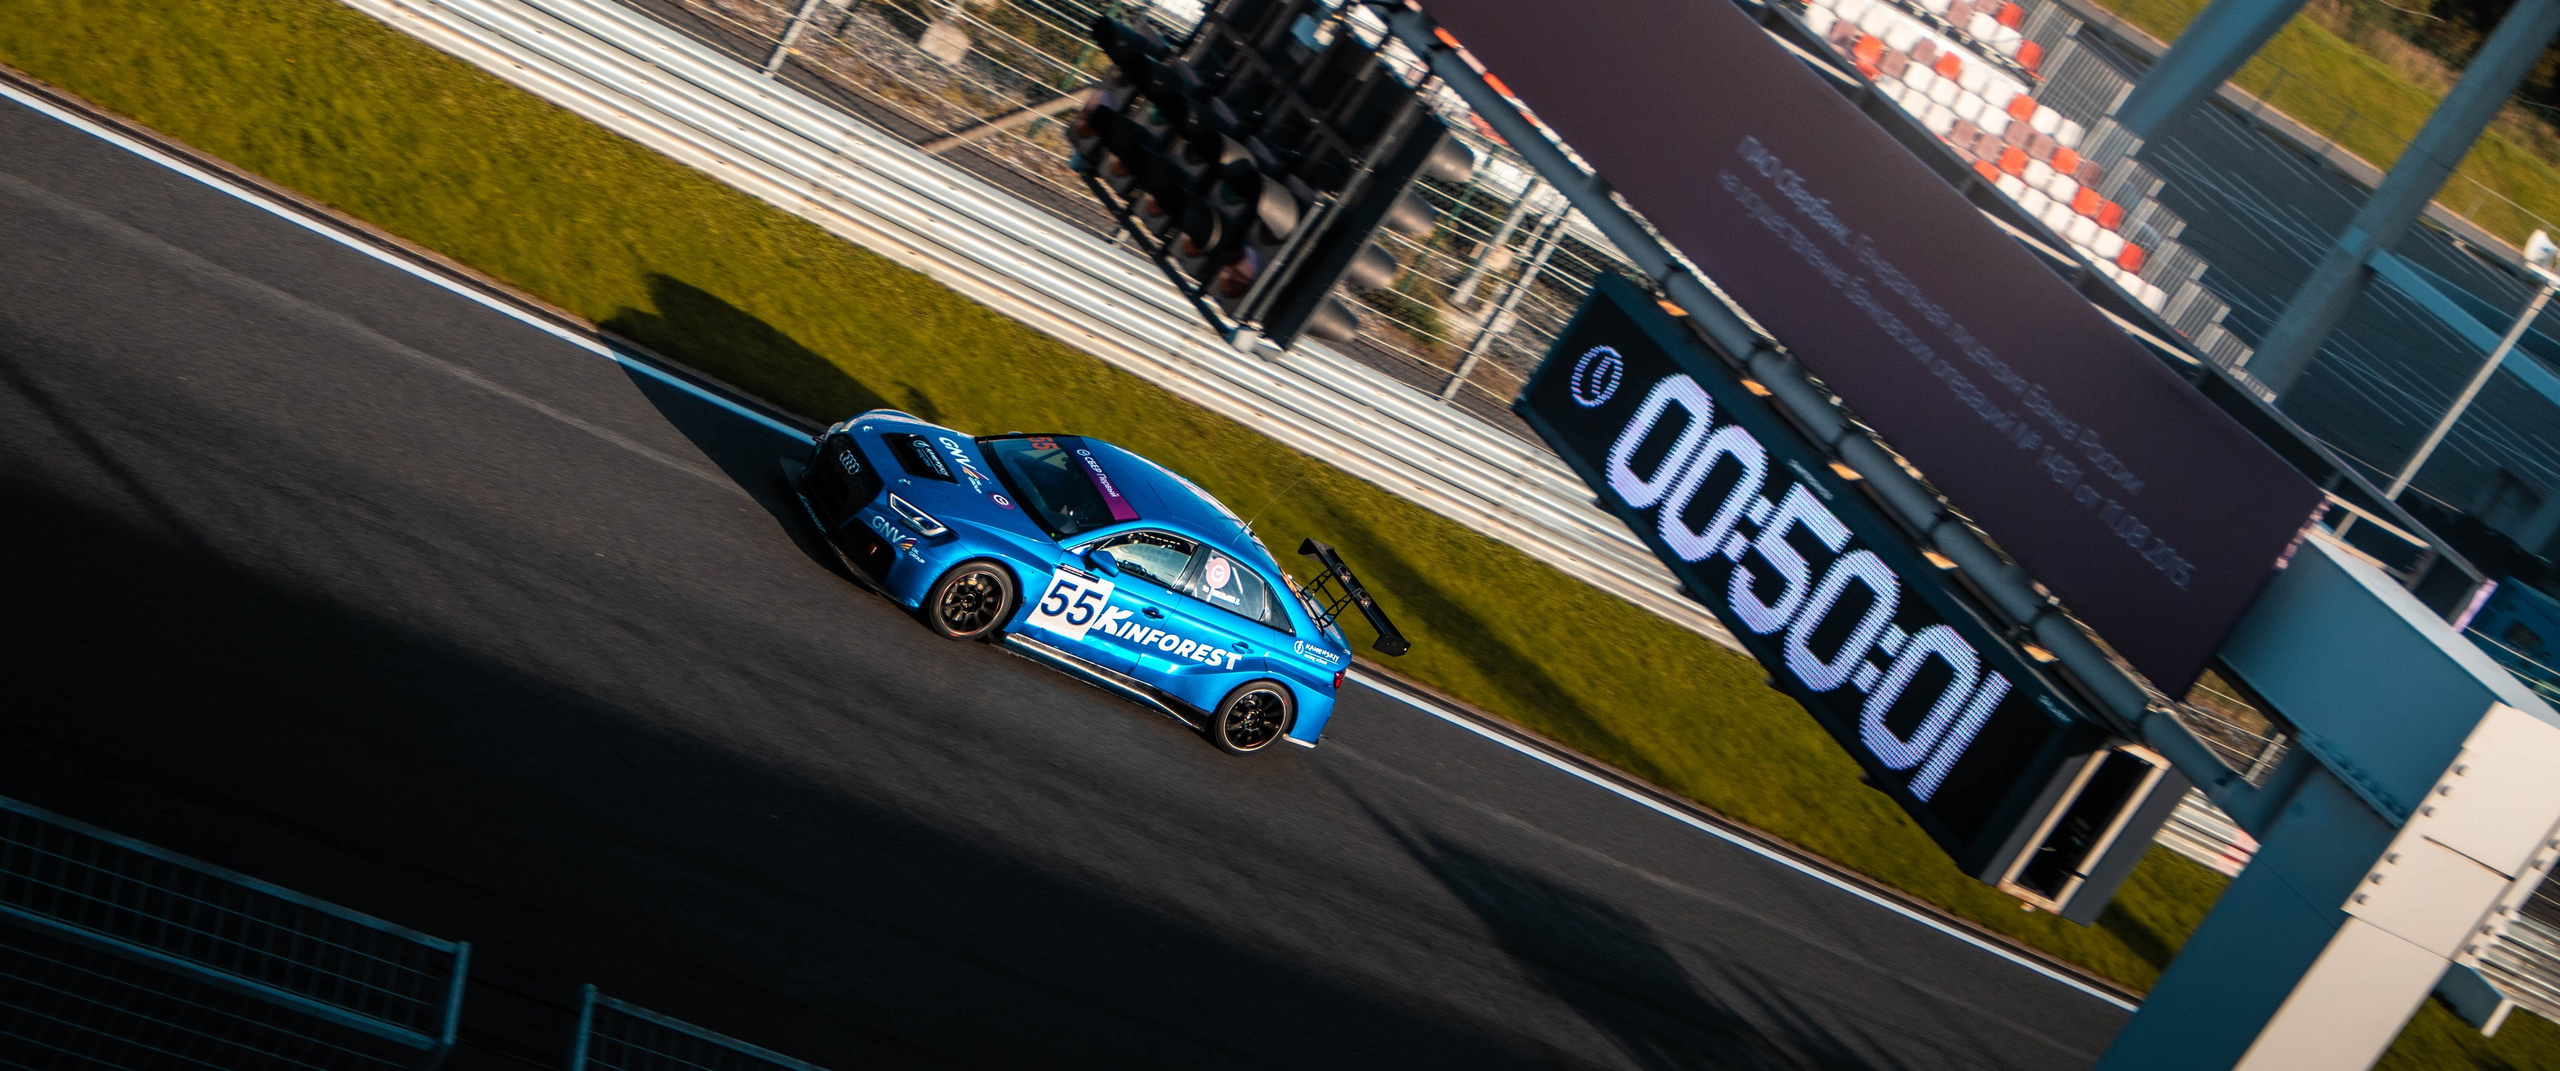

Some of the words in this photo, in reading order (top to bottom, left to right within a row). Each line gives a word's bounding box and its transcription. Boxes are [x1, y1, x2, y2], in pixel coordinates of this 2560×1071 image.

[939, 437, 977, 470] GNV
[1027, 436, 1059, 450] 55
[1084, 456, 1103, 473] СБЕР
[872, 515, 906, 543] GNV
[1040, 579, 1104, 626] 55
[1606, 373, 2014, 802] 00:50:01
[1091, 605, 1243, 670] KINFOREST
